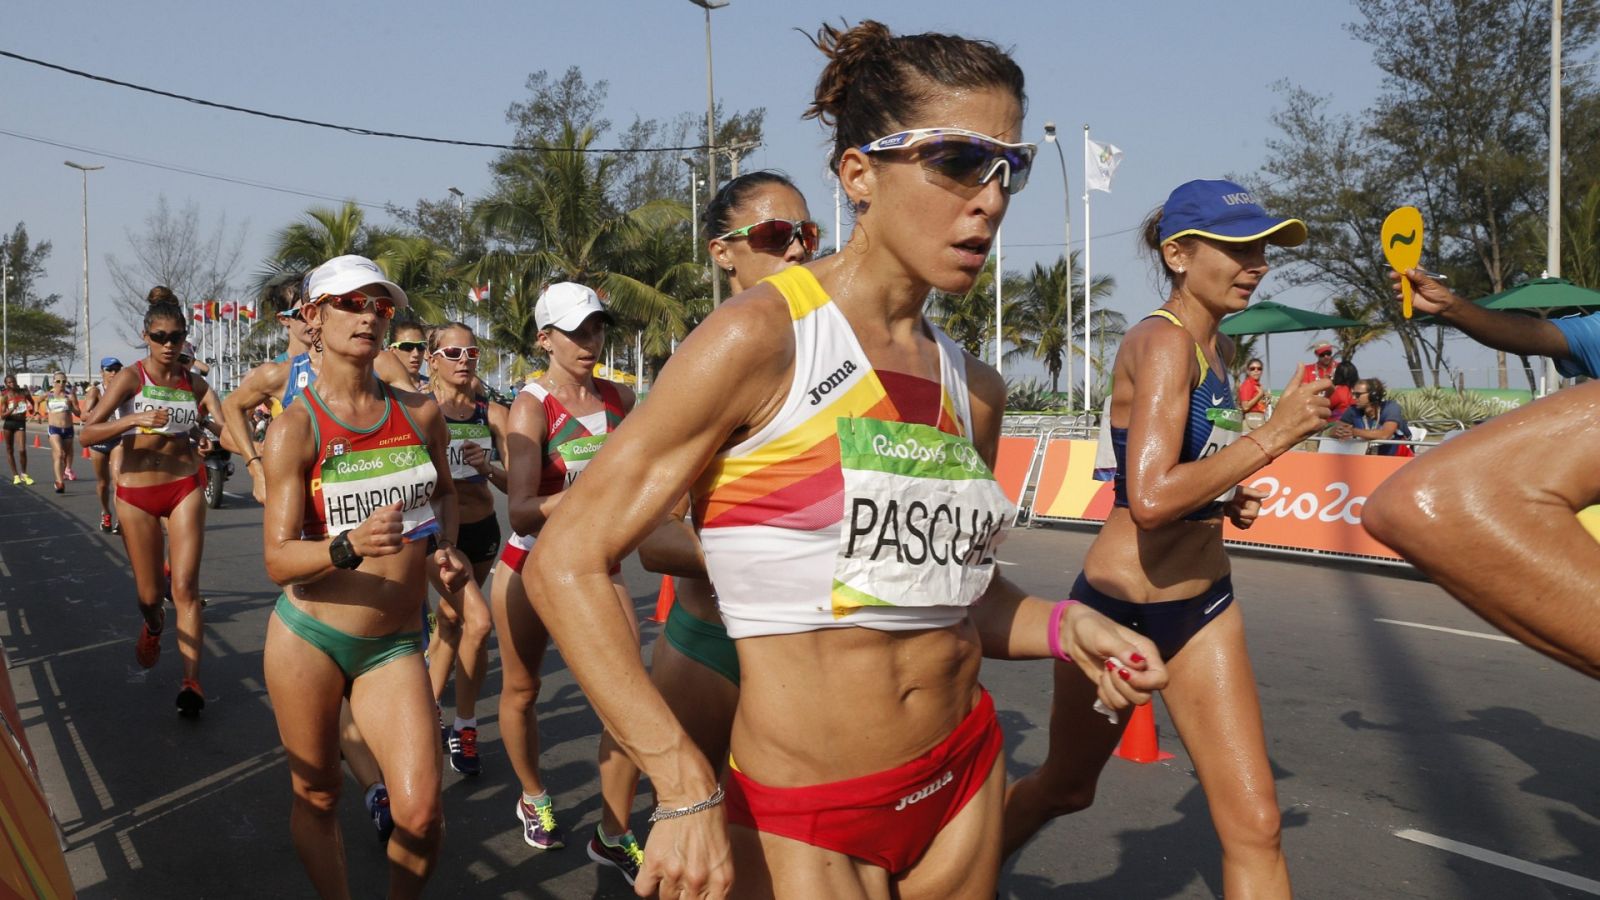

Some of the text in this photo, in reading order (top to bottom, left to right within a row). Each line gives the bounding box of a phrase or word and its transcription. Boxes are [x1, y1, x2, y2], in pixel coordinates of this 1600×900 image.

[808, 360, 857, 406] Joma
[379, 433, 412, 446] OUTPACE
[873, 434, 946, 464] Rio2016
[337, 456, 384, 475] Rio2016
[1249, 476, 1368, 525] Rio20
[895, 771, 953, 811] Joma
